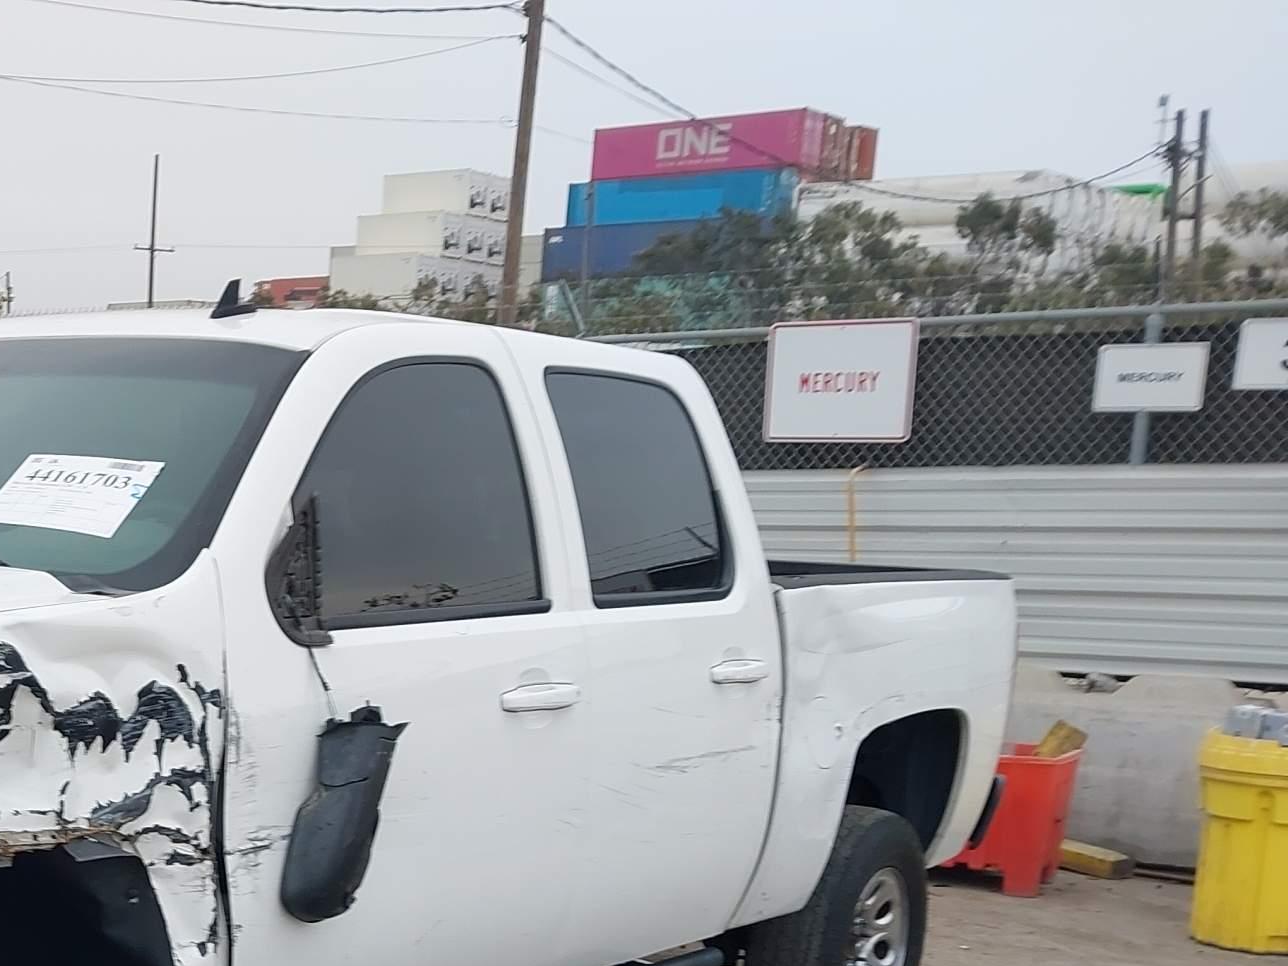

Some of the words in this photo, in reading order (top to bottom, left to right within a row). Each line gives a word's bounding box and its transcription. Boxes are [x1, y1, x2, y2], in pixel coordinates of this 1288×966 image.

[656, 122, 733, 160] ONE
[798, 370, 881, 394] MERCURY
[1117, 371, 1185, 384] MERCURY
[25, 468, 133, 490] 44161703
